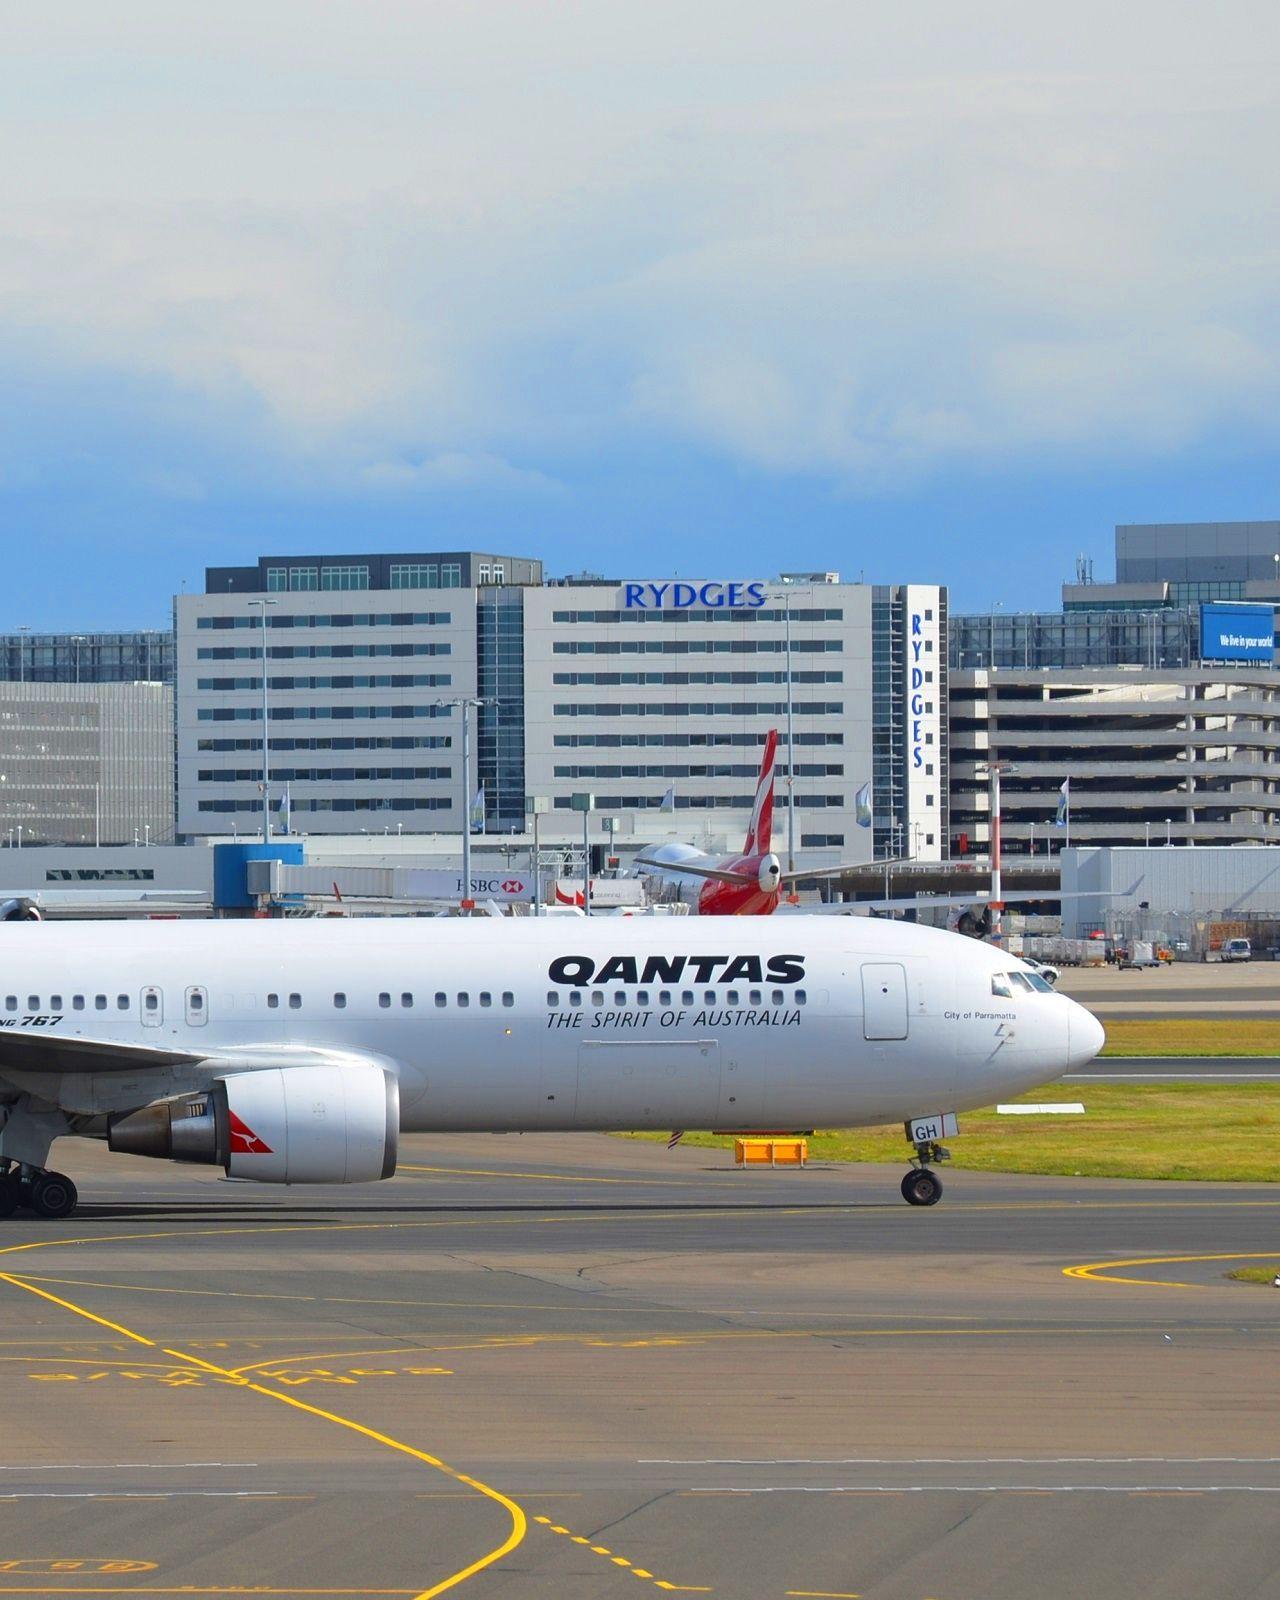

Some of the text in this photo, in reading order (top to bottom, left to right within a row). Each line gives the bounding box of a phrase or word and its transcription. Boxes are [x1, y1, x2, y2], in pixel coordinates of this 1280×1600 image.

[625, 583, 766, 608] RYDGES
[1220, 634, 1229, 647] We
[1245, 637, 1257, 650] your
[1258, 635, 1273, 648] world
[911, 614, 924, 768] RYDGES
[548, 955, 806, 987] QANTAS
[20, 1016, 64, 1027] 767
[547, 1010, 802, 1028] THE SPIRIT OF AUSTRALIA
[943, 1011, 1017, 1021] City of Parramatta
[915, 1124, 938, 1141] GH
